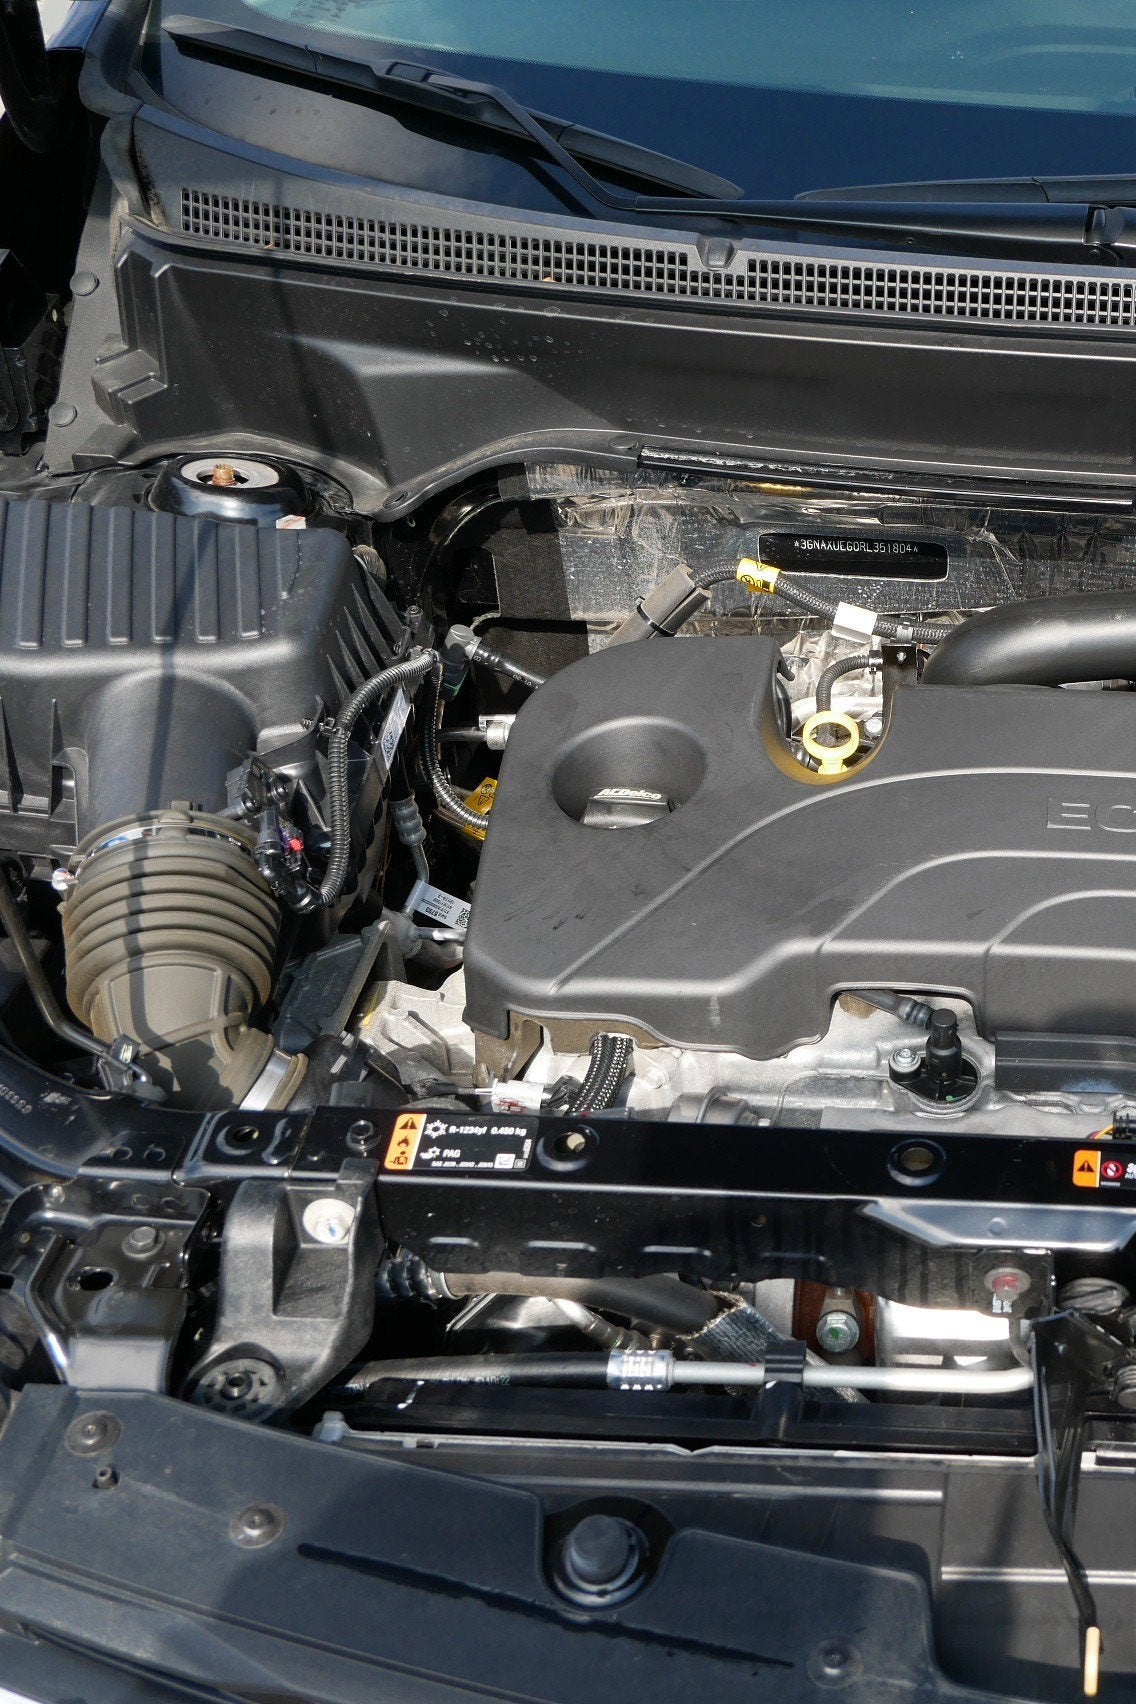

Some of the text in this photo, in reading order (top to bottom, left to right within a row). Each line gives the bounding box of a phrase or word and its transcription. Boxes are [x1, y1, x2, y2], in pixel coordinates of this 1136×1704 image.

[594, 788, 661, 800] ACDelco
[449, 1125, 527, 1137] R-1234yf 0.450 kg
[442, 1149, 461, 1158] PAG
